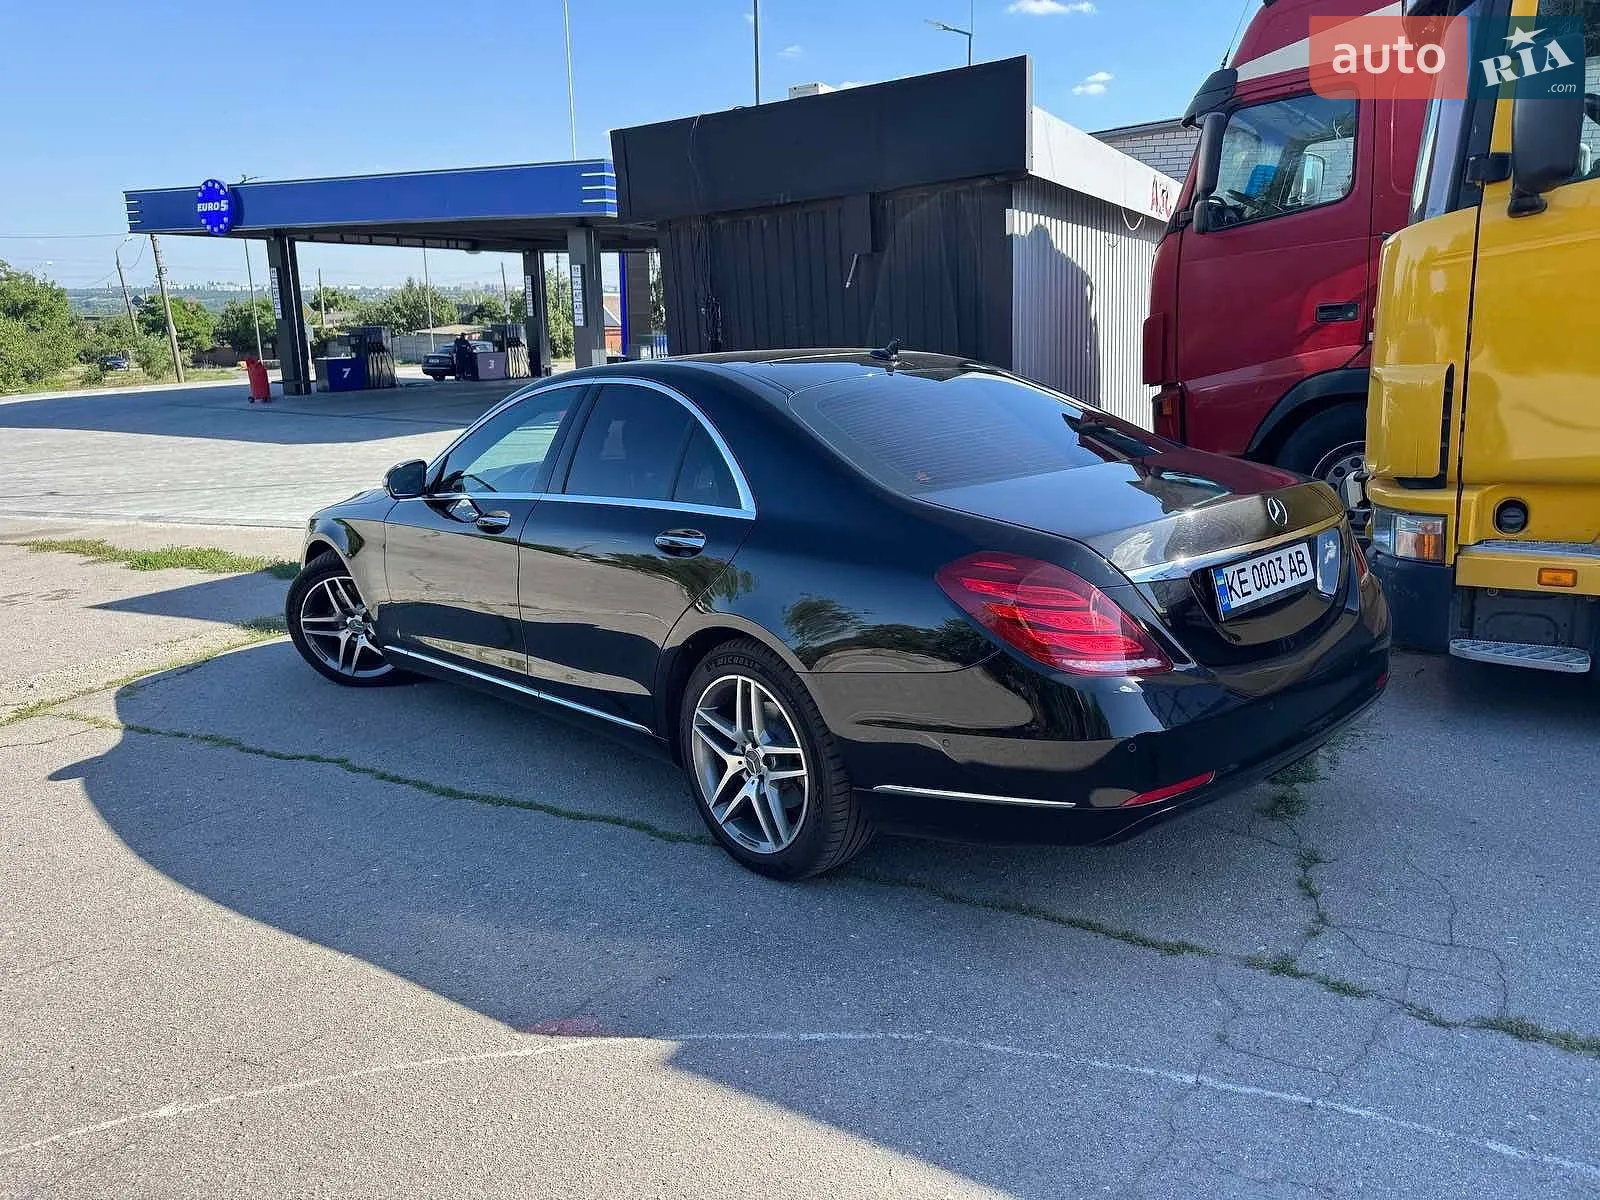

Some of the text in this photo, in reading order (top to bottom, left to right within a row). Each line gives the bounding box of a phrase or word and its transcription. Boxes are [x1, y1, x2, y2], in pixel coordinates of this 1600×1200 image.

[342, 367, 352, 379] 7
[1225, 550, 1308, 602] KE 0003 AB
